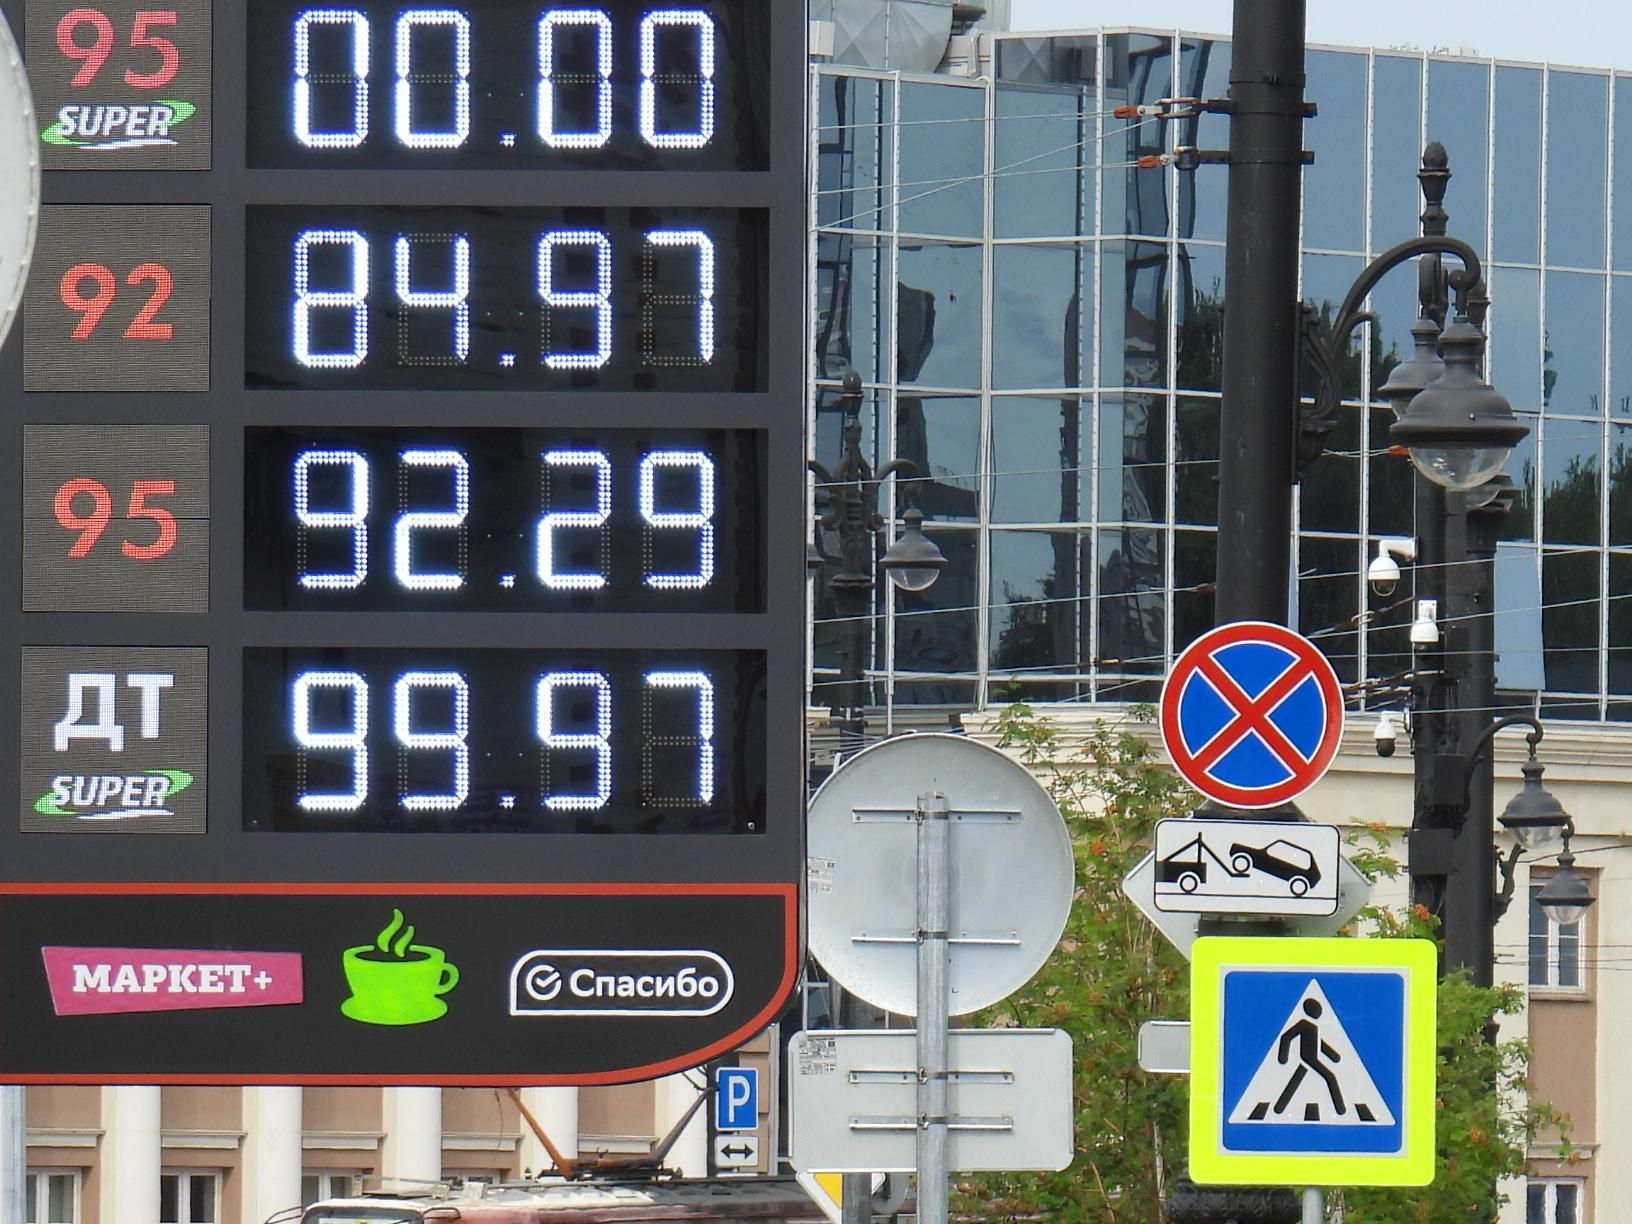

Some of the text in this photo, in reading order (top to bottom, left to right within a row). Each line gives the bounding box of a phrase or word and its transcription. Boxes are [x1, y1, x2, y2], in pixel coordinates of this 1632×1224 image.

[56, 8, 181, 88] 95
[293, 10, 716, 149] 00.00
[57, 104, 174, 136] SUPER
[60, 263, 174, 340] 92
[293, 230, 714, 369] 84.97
[54, 477, 178, 560] 95
[293, 450, 714, 590] 92.29
[54, 672, 174, 751] ДТ
[293, 671, 714, 810] 99.97
[52, 775, 171, 806] SUPER
[73, 964, 273, 993] МАРКЕТ+
[570, 967, 719, 998] Спасибо
[728, 1075, 750, 1123] P
